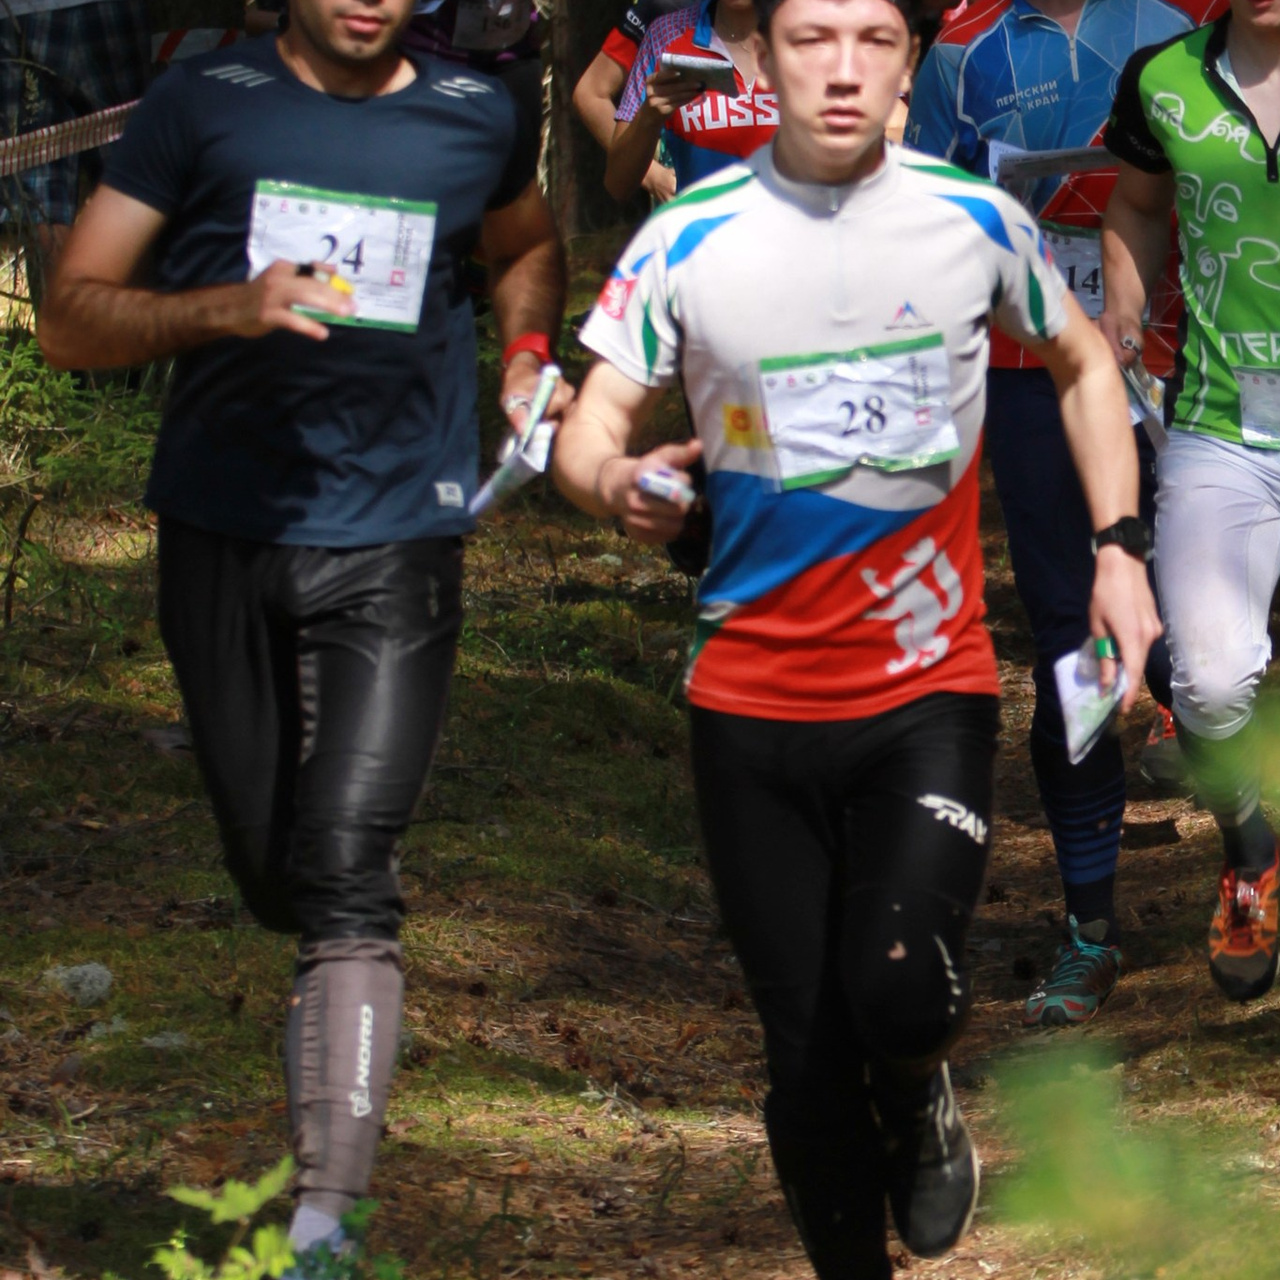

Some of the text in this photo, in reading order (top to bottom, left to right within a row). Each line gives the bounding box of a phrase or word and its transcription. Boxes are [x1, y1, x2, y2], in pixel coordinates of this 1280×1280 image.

[320, 234, 365, 275] 24
[1066, 265, 1101, 295] 14
[838, 395, 887, 437] 28
